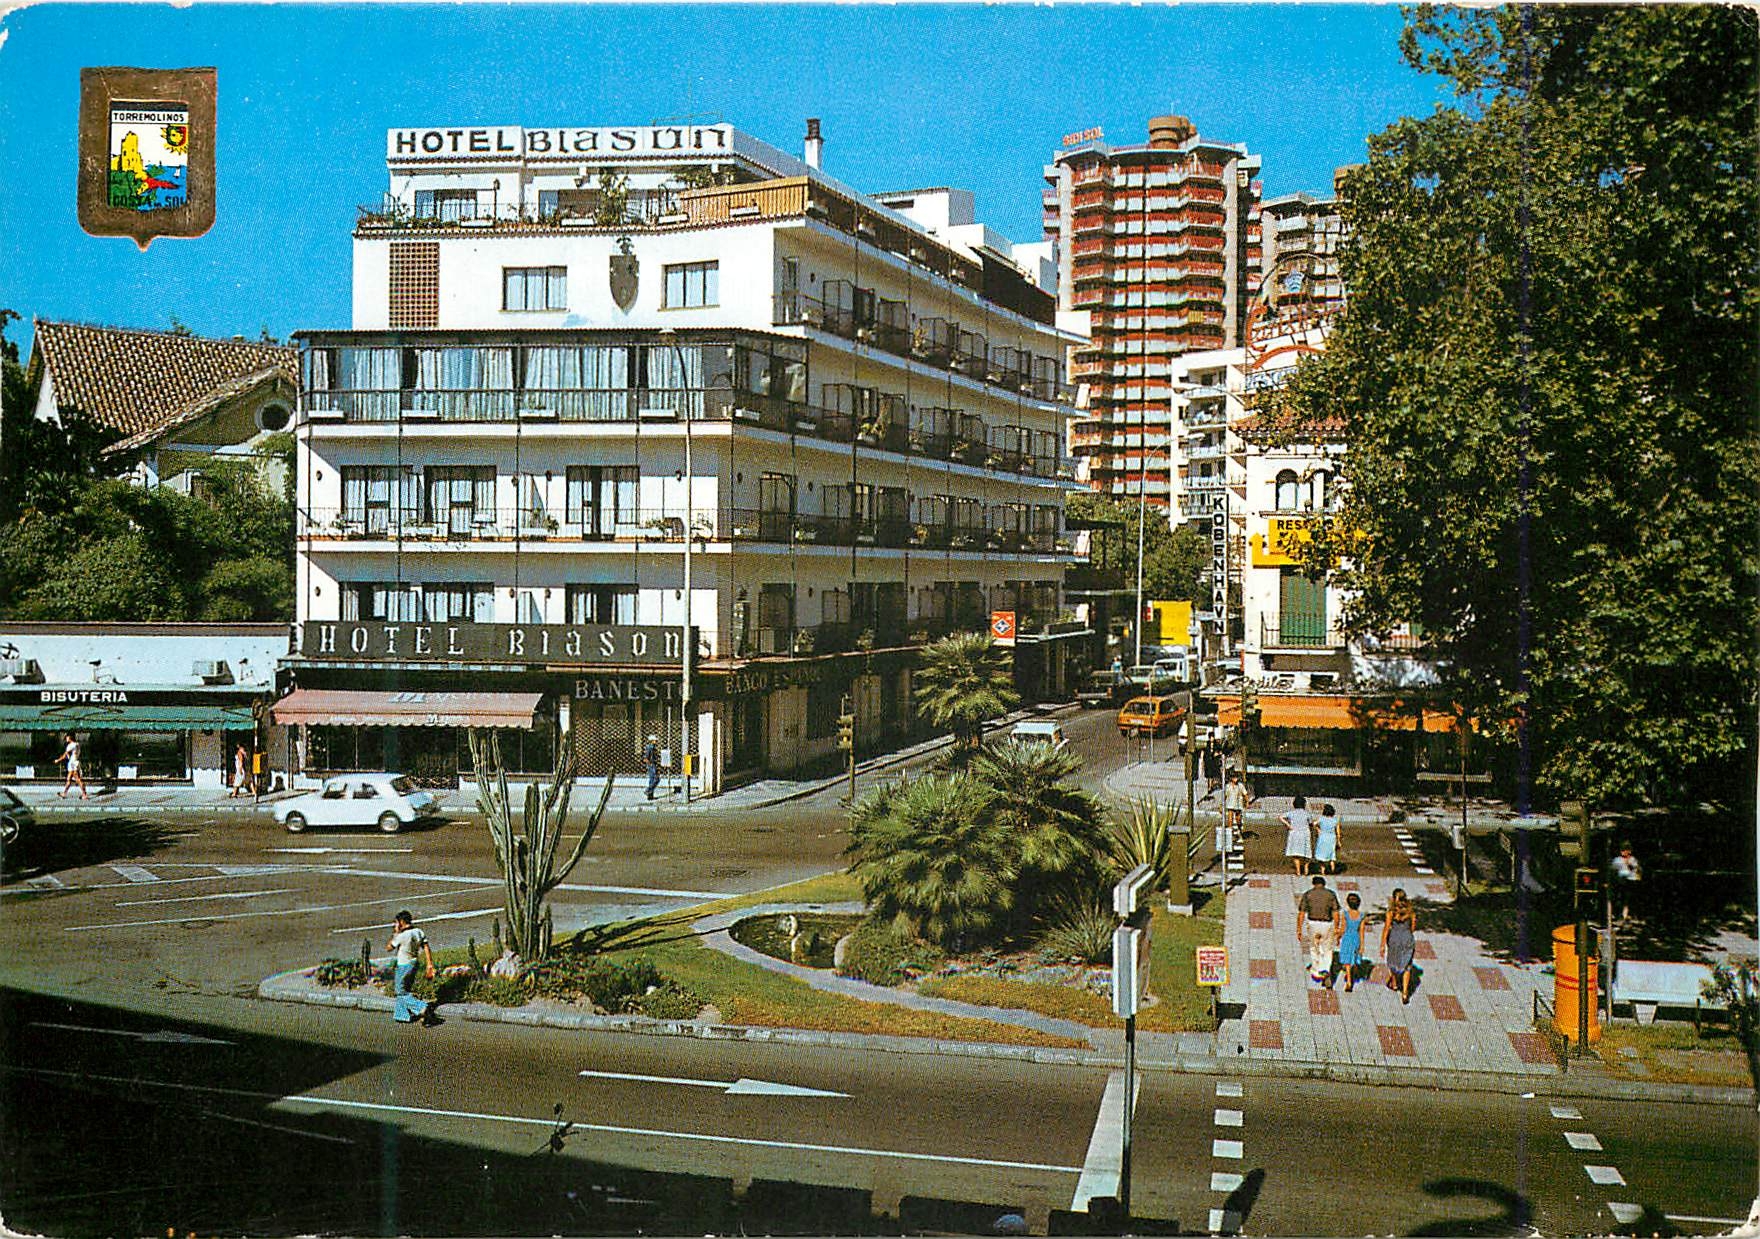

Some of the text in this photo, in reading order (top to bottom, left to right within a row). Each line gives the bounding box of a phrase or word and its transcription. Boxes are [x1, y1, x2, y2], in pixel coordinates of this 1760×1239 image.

[396, 128, 514, 154] HOTEL
[319, 625, 465, 655] HOTEL
[40, 690, 128, 703] BISUTERIA
